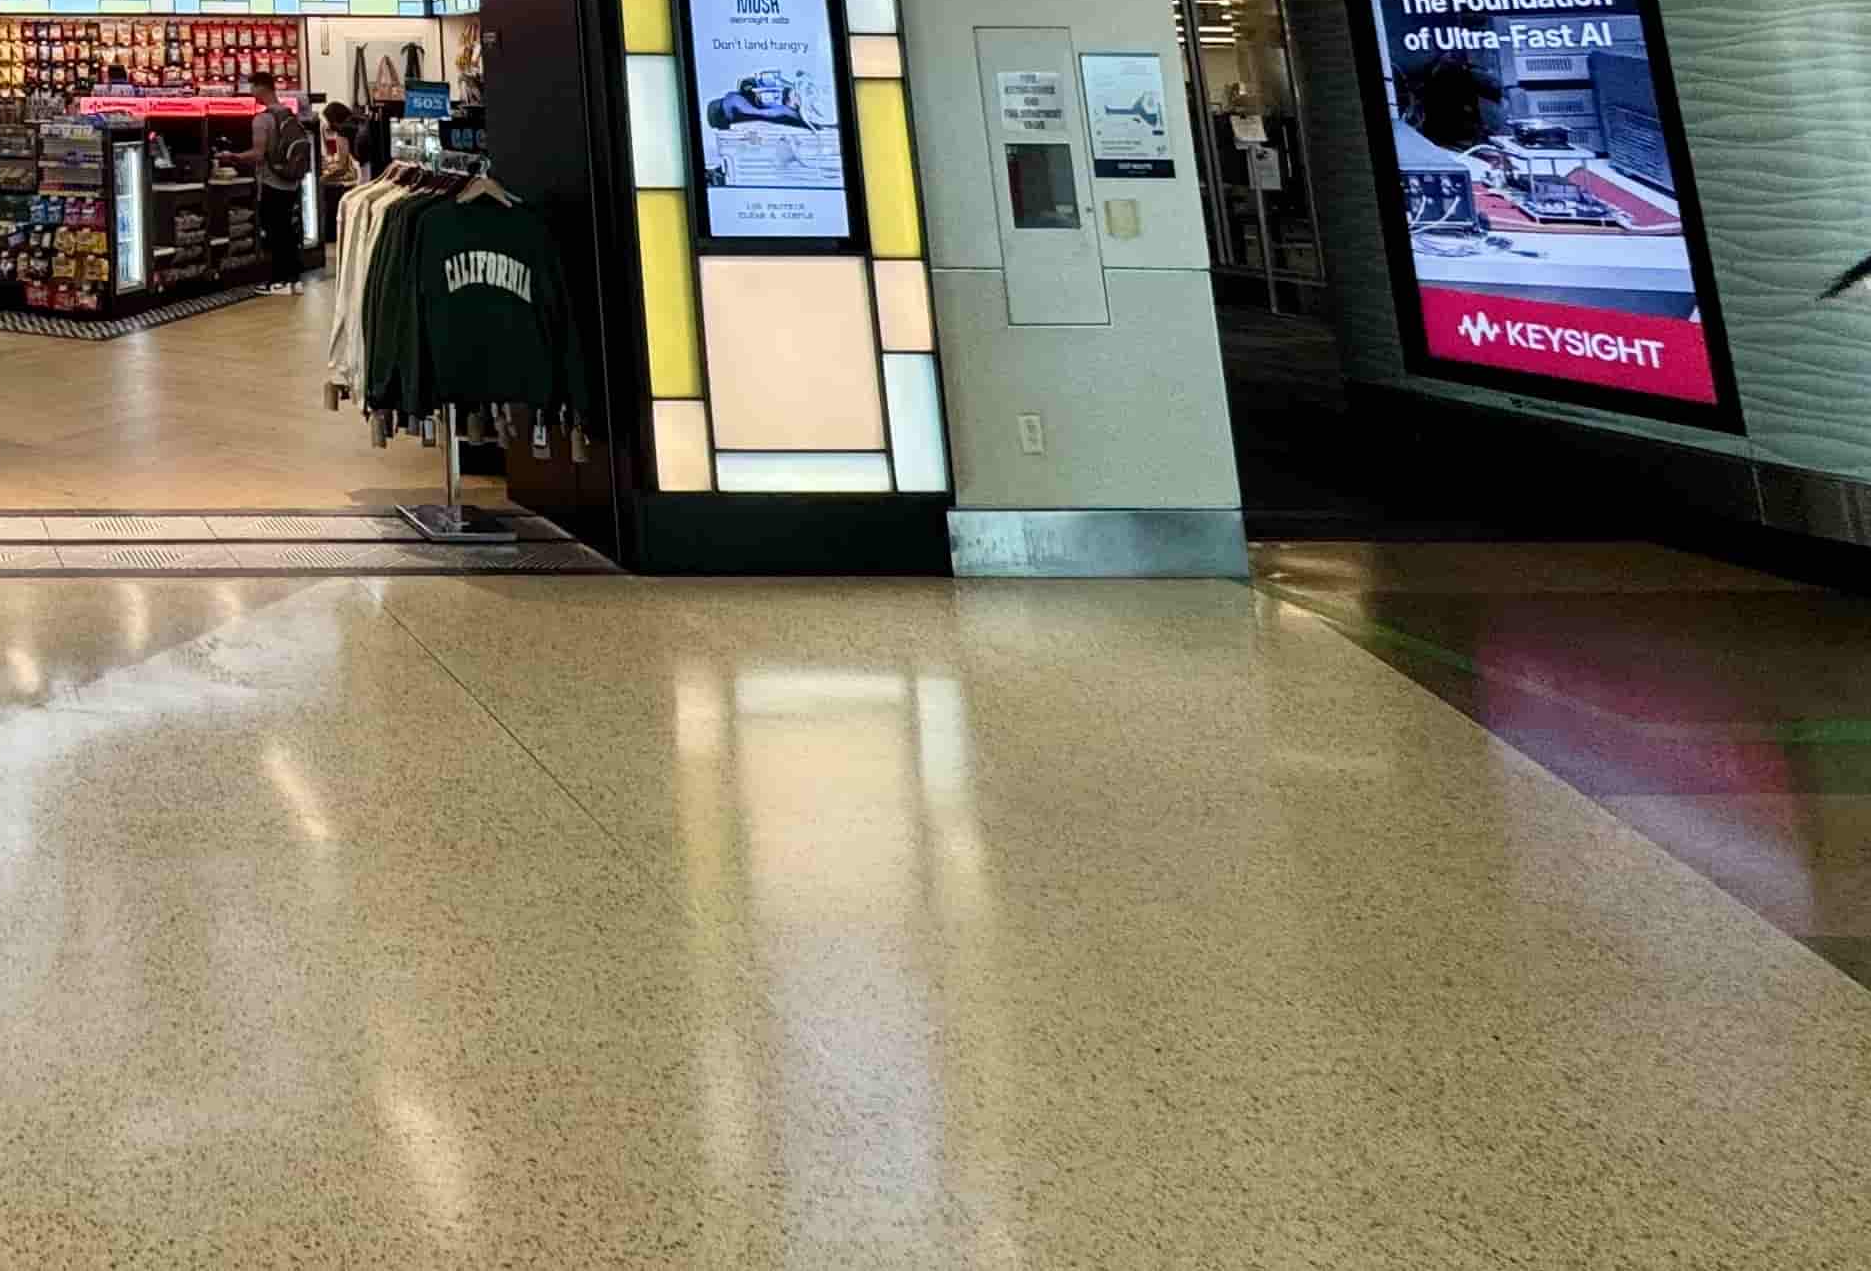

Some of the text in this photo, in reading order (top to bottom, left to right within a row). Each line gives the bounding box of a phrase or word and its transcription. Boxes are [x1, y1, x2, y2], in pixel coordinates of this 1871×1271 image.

[712, 37, 741, 50] Don't
[743, 37, 769, 50] land
[1403, 21, 1613, 53] of Ultra-Fast AI
[444, 250, 532, 304] CALIFORNIA
[1506, 319, 1666, 370] KEYSIGHT
